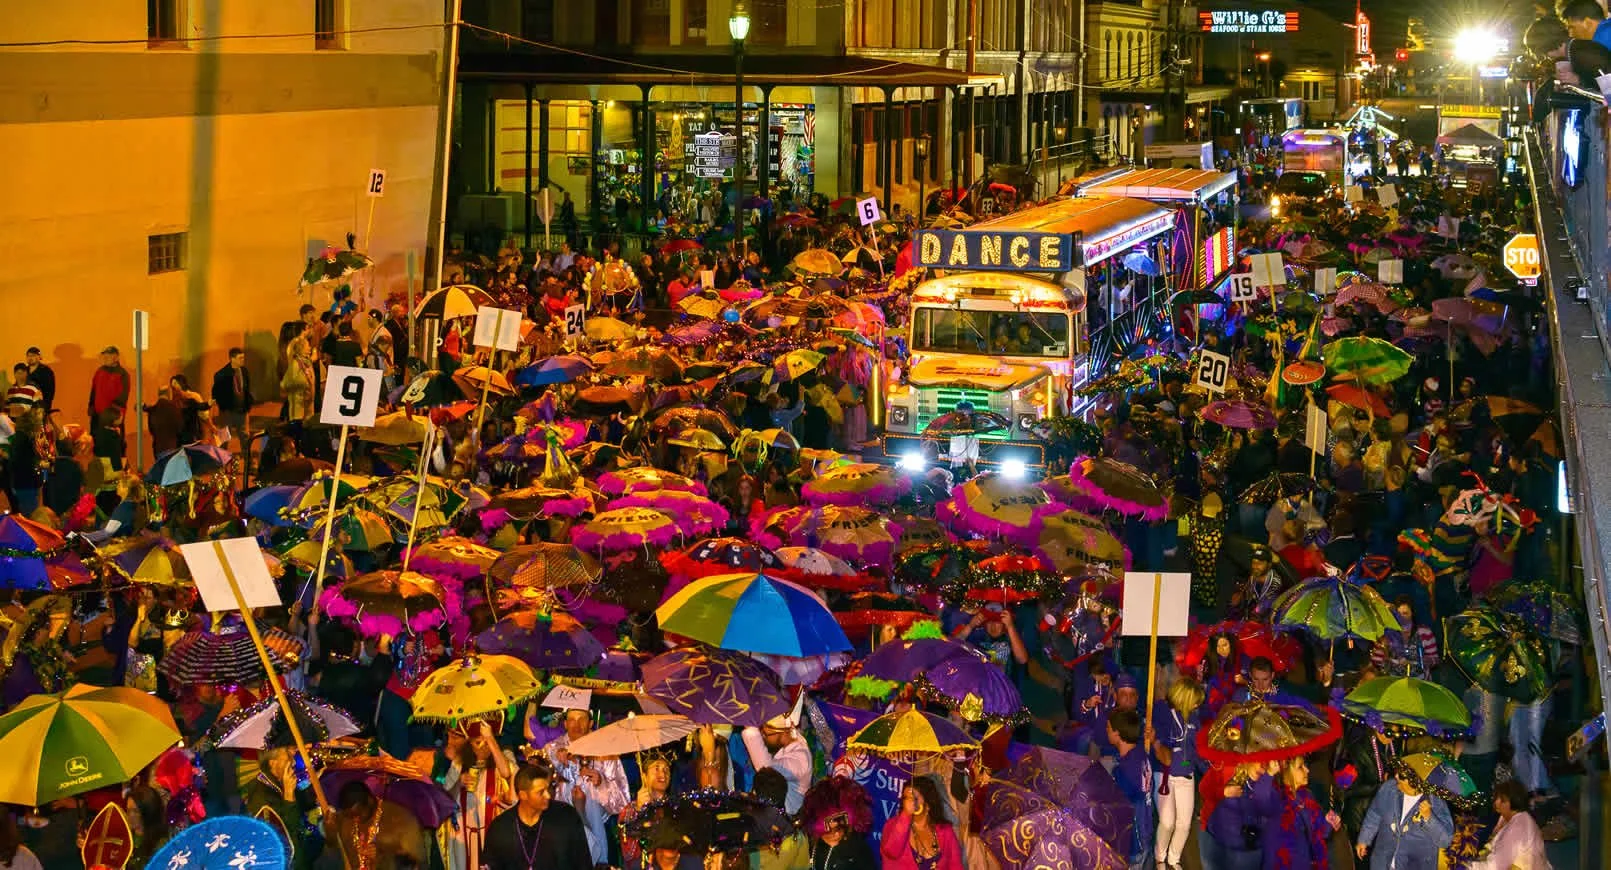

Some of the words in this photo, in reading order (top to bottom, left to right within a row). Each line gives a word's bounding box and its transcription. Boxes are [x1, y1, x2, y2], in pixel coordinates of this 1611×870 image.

[1211, 11, 1258, 24] Willie
[1261, 10, 1286, 24] G's
[370, 172, 383, 193] 12
[863, 202, 874, 220] 6
[920, 232, 1061, 268] DANCE
[1507, 247, 1540, 265] STO
[1233, 276, 1253, 298] 19
[567, 309, 584, 335] 24
[1200, 355, 1226, 388] 20
[339, 375, 365, 417] 9
[59, 780, 78, 789] JOHN
[79, 772, 102, 783] DEERE
